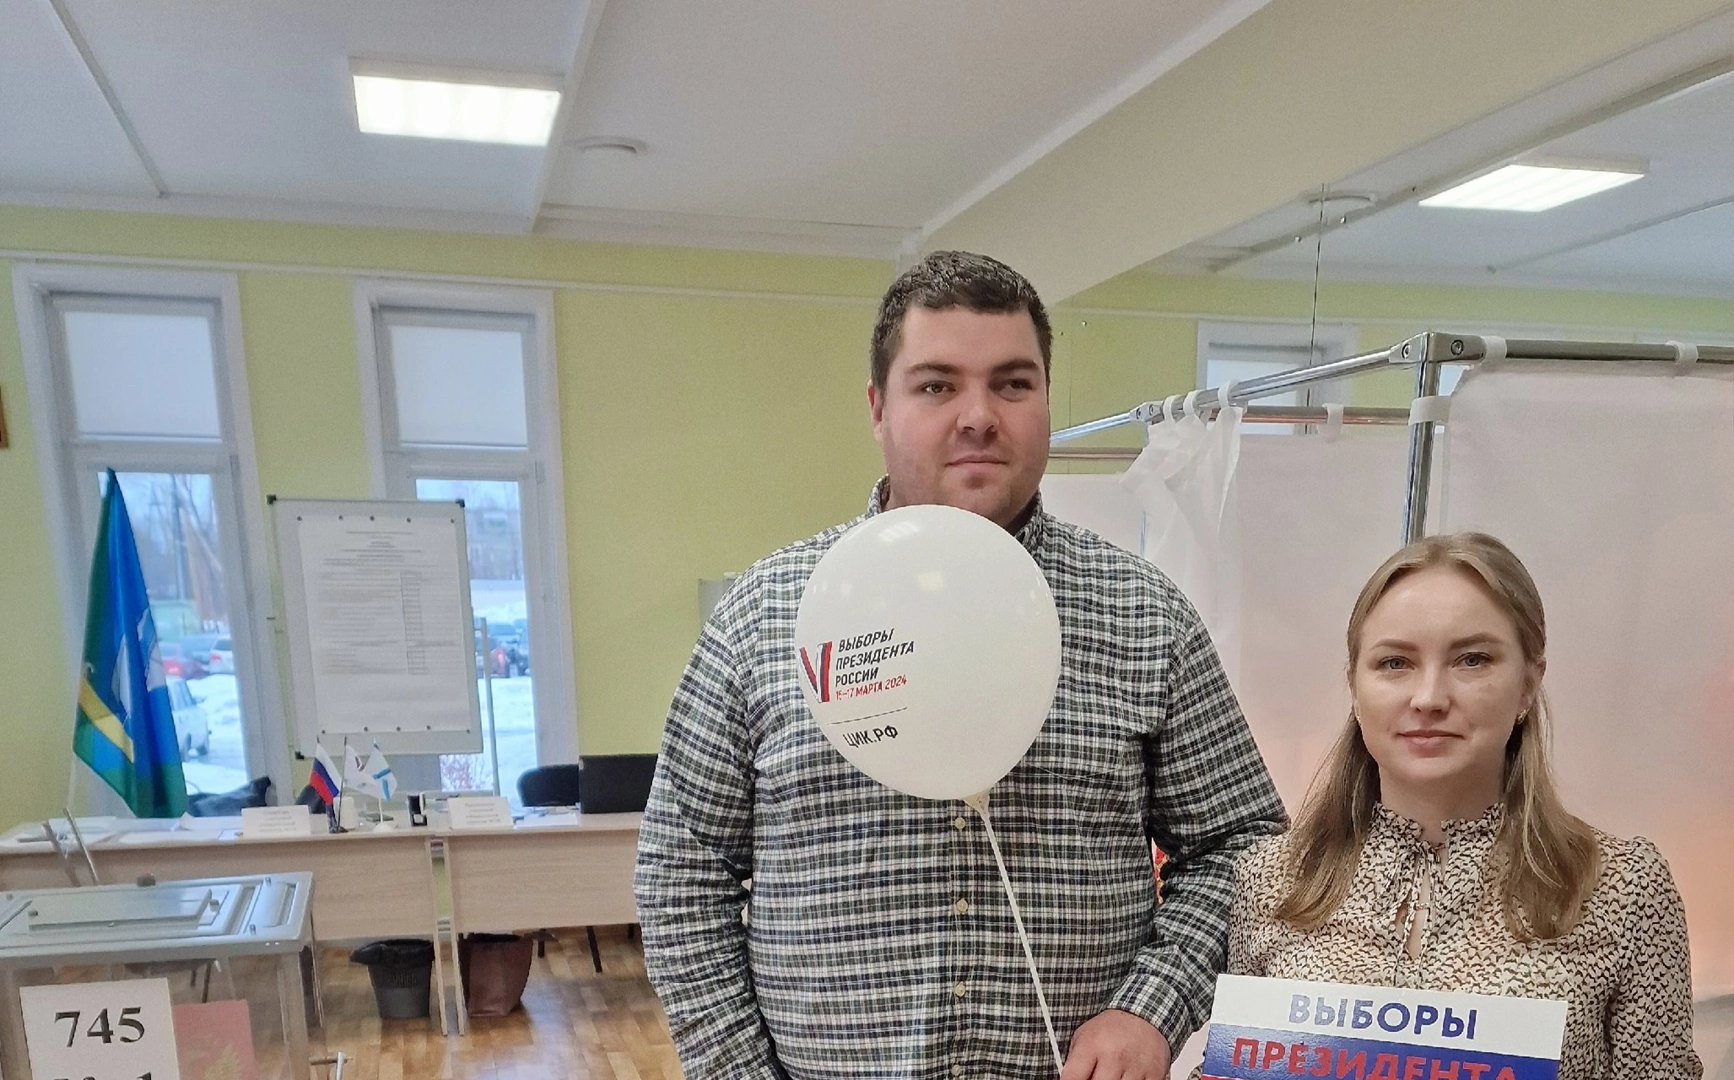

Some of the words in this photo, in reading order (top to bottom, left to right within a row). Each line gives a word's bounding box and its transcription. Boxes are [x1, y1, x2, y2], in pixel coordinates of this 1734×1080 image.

[838, 628, 895, 652] ВЫБОРЫ
[836, 641, 915, 671] ПРЕЗИДЕНТА
[835, 667, 879, 687] РОССИИ
[855, 681, 883, 696] МАРТА
[885, 674, 908, 690] 2024
[842, 725, 899, 748] ЦИК.РФ
[53, 1006, 145, 1048] 745
[1288, 993, 1478, 1040] ВЫБОРЫ
